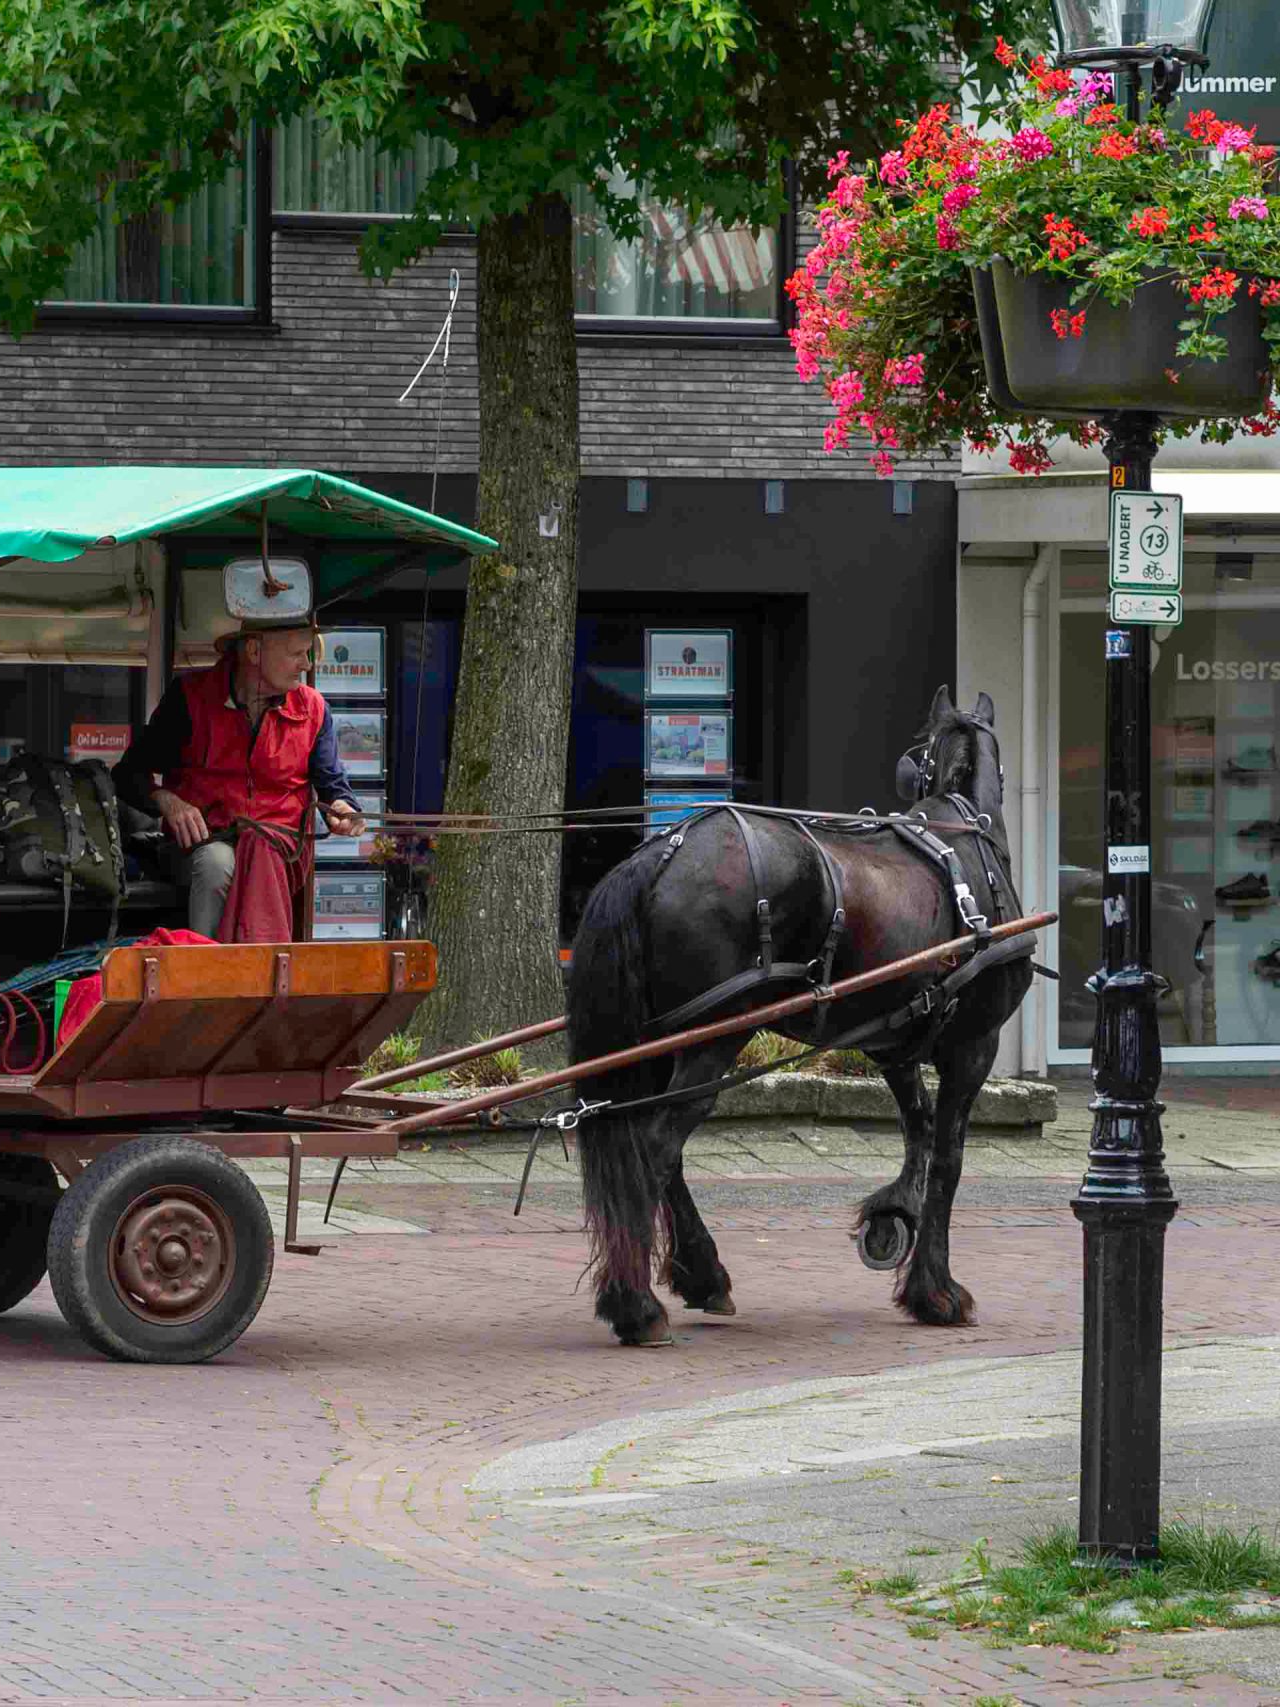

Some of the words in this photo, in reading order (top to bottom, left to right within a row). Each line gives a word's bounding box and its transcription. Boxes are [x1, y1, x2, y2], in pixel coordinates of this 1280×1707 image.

[1176, 69, 1276, 93] ummer
[1114, 468, 1123, 485] 2
[1120, 504, 1131, 560] NADERT
[1145, 533, 1165, 549] 13
[1119, 564, 1130, 573] U
[657, 666, 721, 677] STRAATMAN
